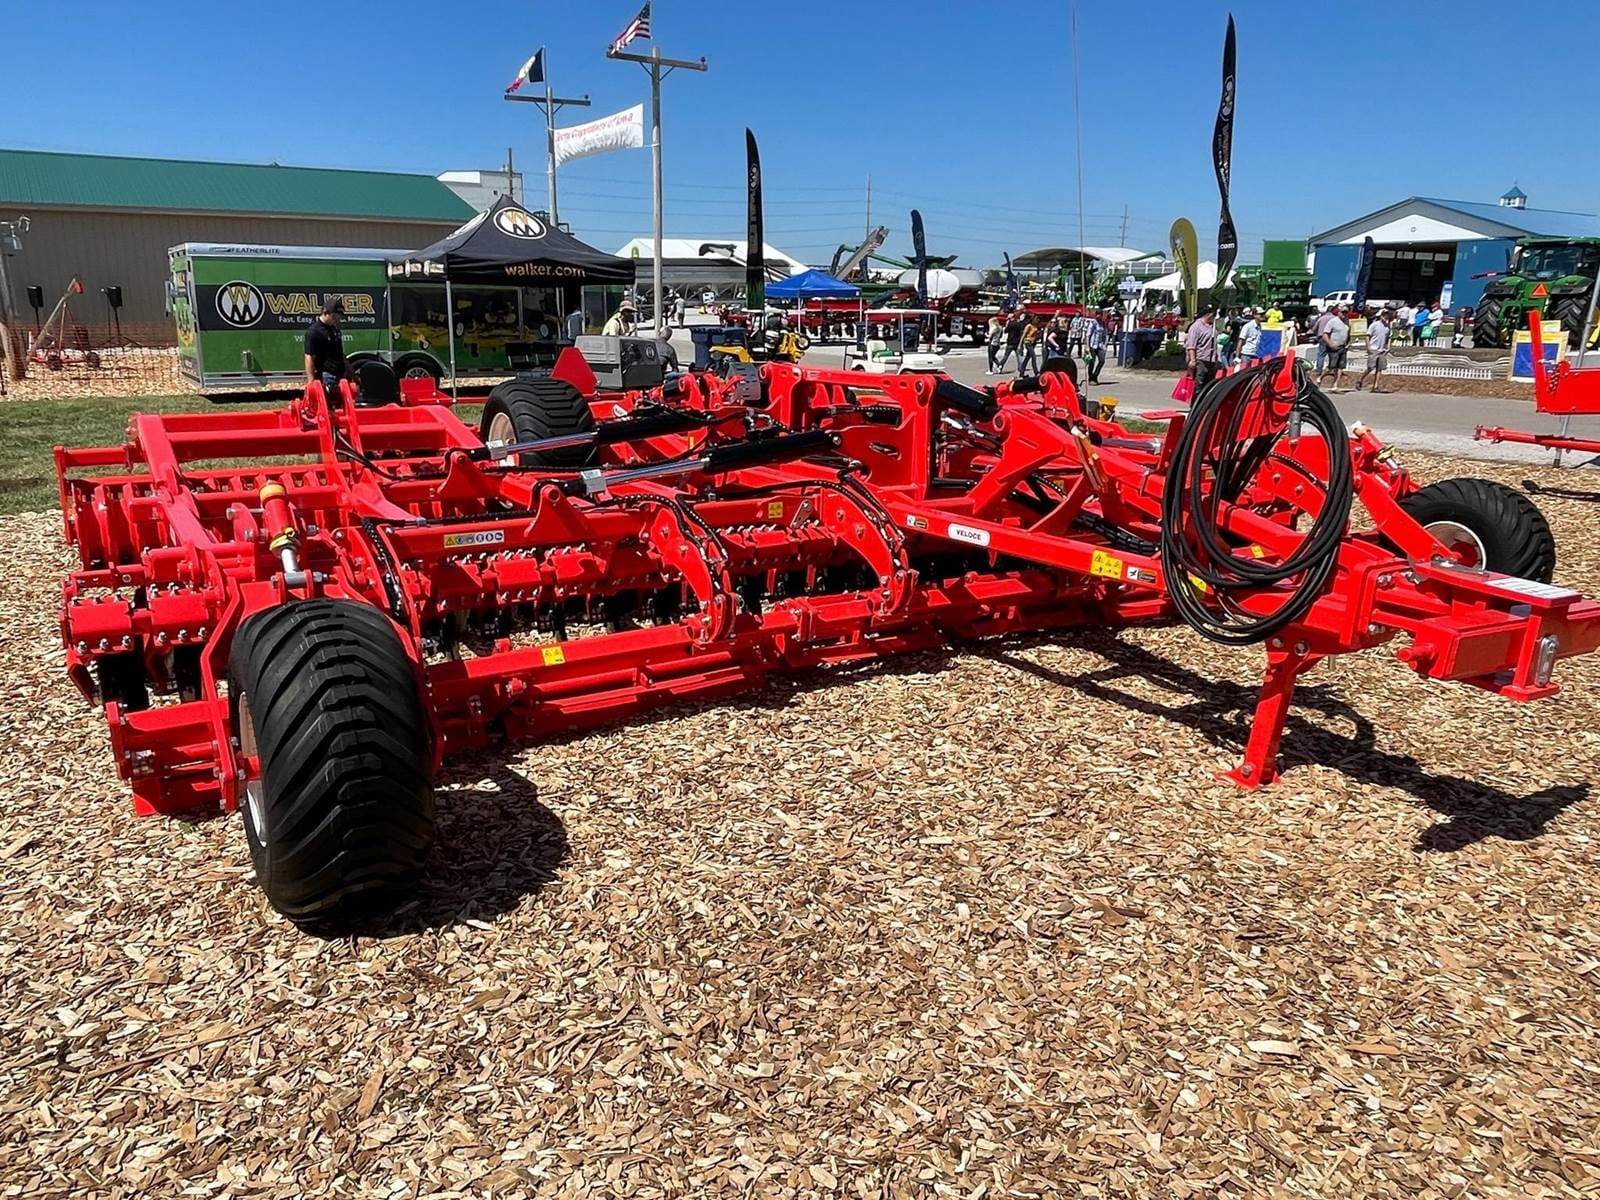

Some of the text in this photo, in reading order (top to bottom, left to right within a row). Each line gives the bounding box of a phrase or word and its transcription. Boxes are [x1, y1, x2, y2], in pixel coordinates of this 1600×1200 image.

[231, 247, 281, 255] FEATHERLITE
[504, 262, 586, 278] walker.com
[956, 529, 982, 541] VELOCE
